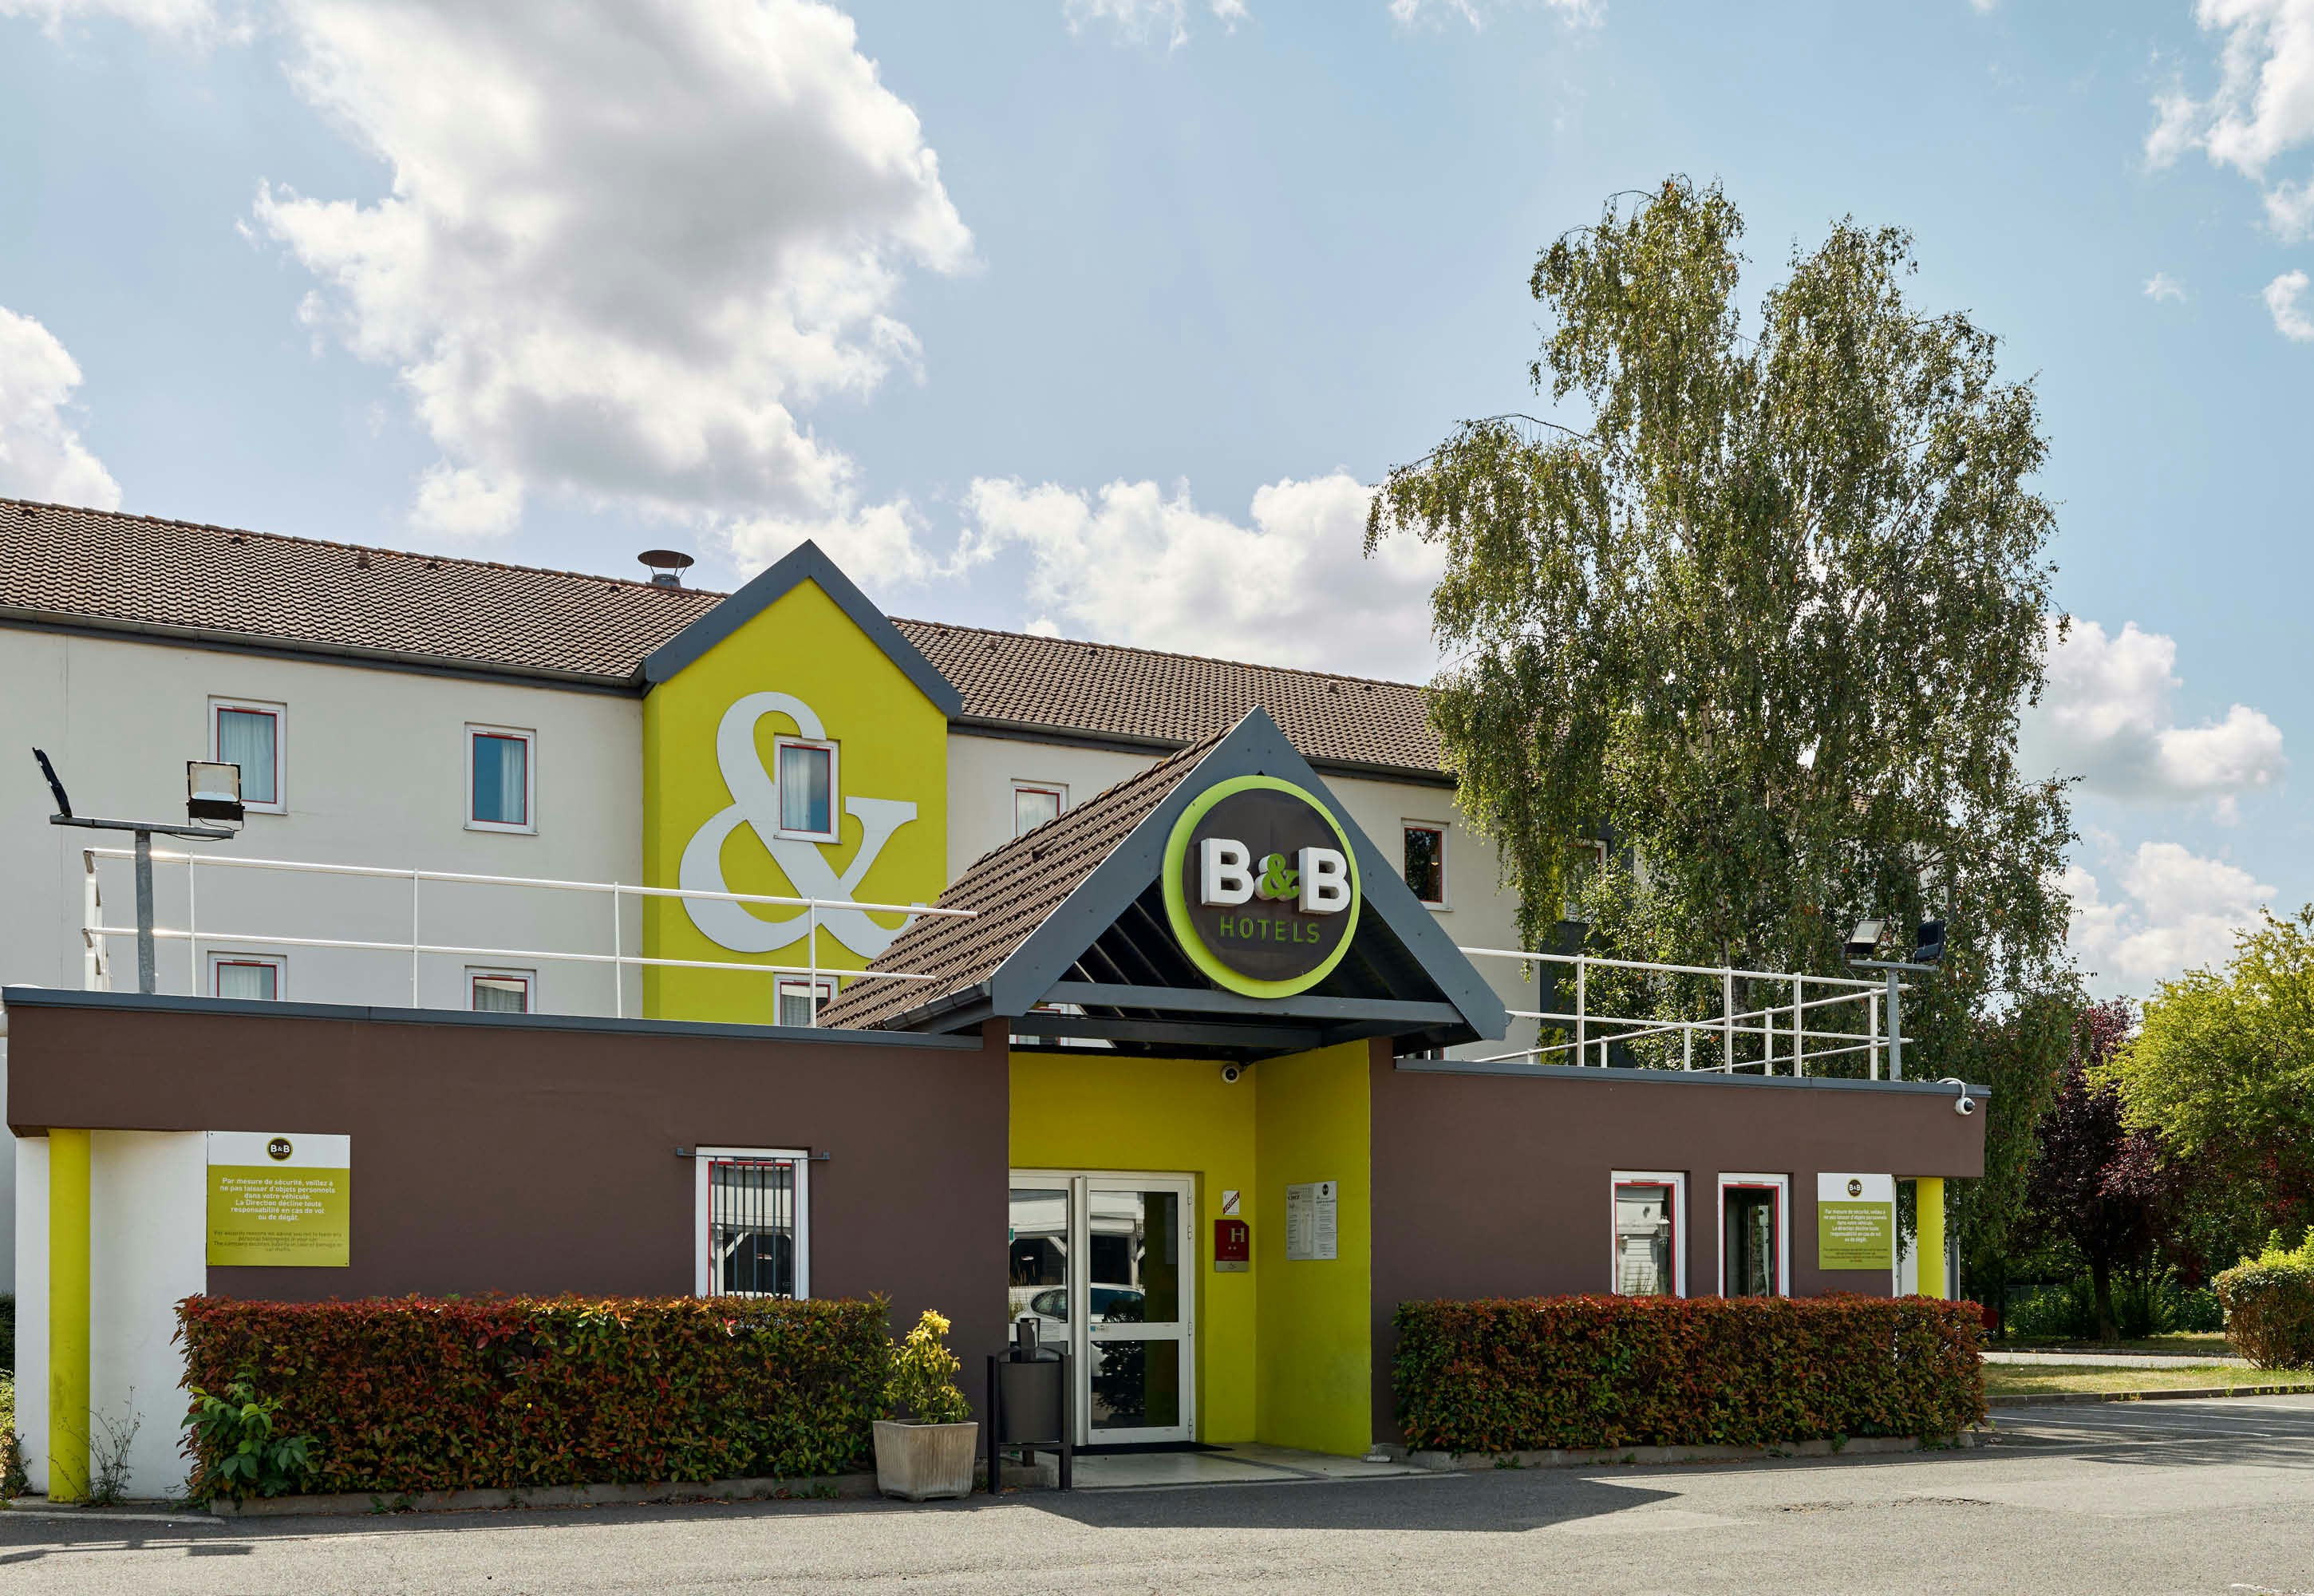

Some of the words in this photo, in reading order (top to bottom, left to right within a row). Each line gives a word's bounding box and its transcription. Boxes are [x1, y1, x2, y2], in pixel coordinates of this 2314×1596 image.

[1200, 838, 1352, 915] B&B
[1219, 915, 1321, 944] HOTELS
[270, 1144, 290, 1153] B&B
[1230, 1227, 1246, 1243] H
